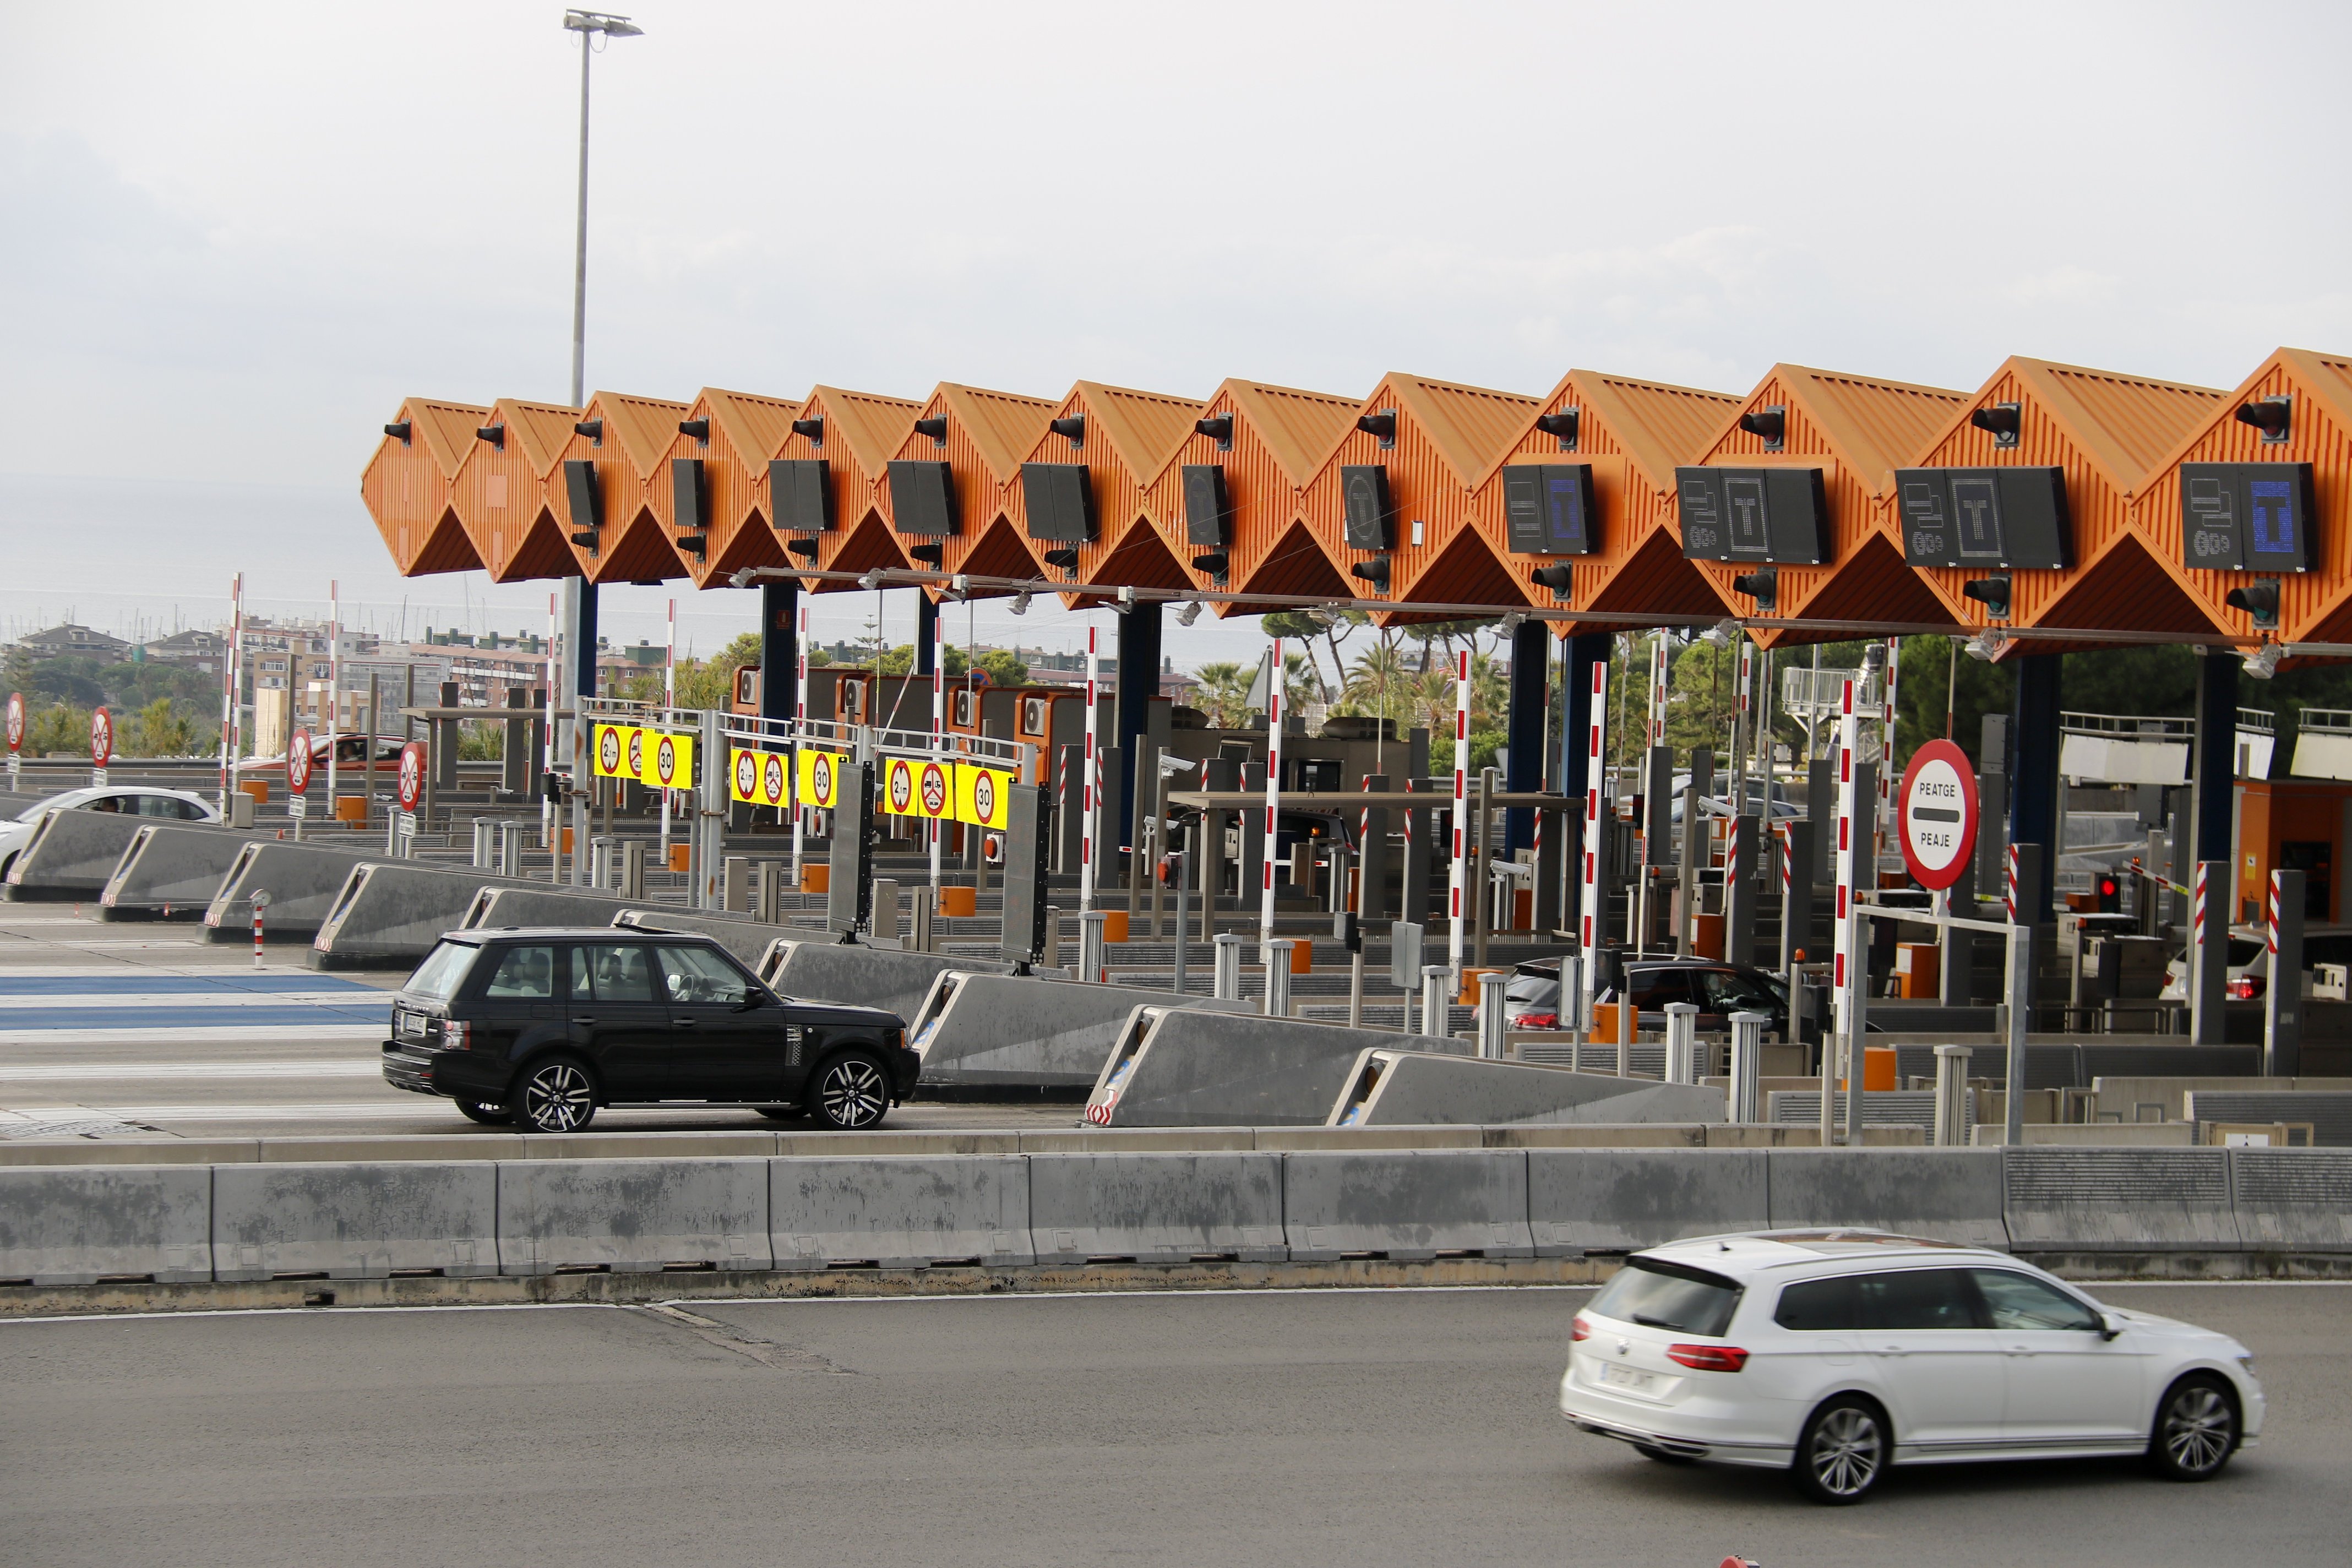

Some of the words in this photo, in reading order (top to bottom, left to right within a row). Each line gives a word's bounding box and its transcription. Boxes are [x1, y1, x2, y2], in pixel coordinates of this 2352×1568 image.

[1353, 493, 1369, 526] T
[1734, 498, 1755, 536] T
[1963, 499, 1988, 540] T
[2257, 496, 2286, 542] T
[661, 753, 671, 769] 30
[817, 771, 827, 788] 30
[979, 788, 989, 806] 30
[1919, 782, 1955, 797] PEATGE
[1921, 832, 1950, 847] PEAJE
